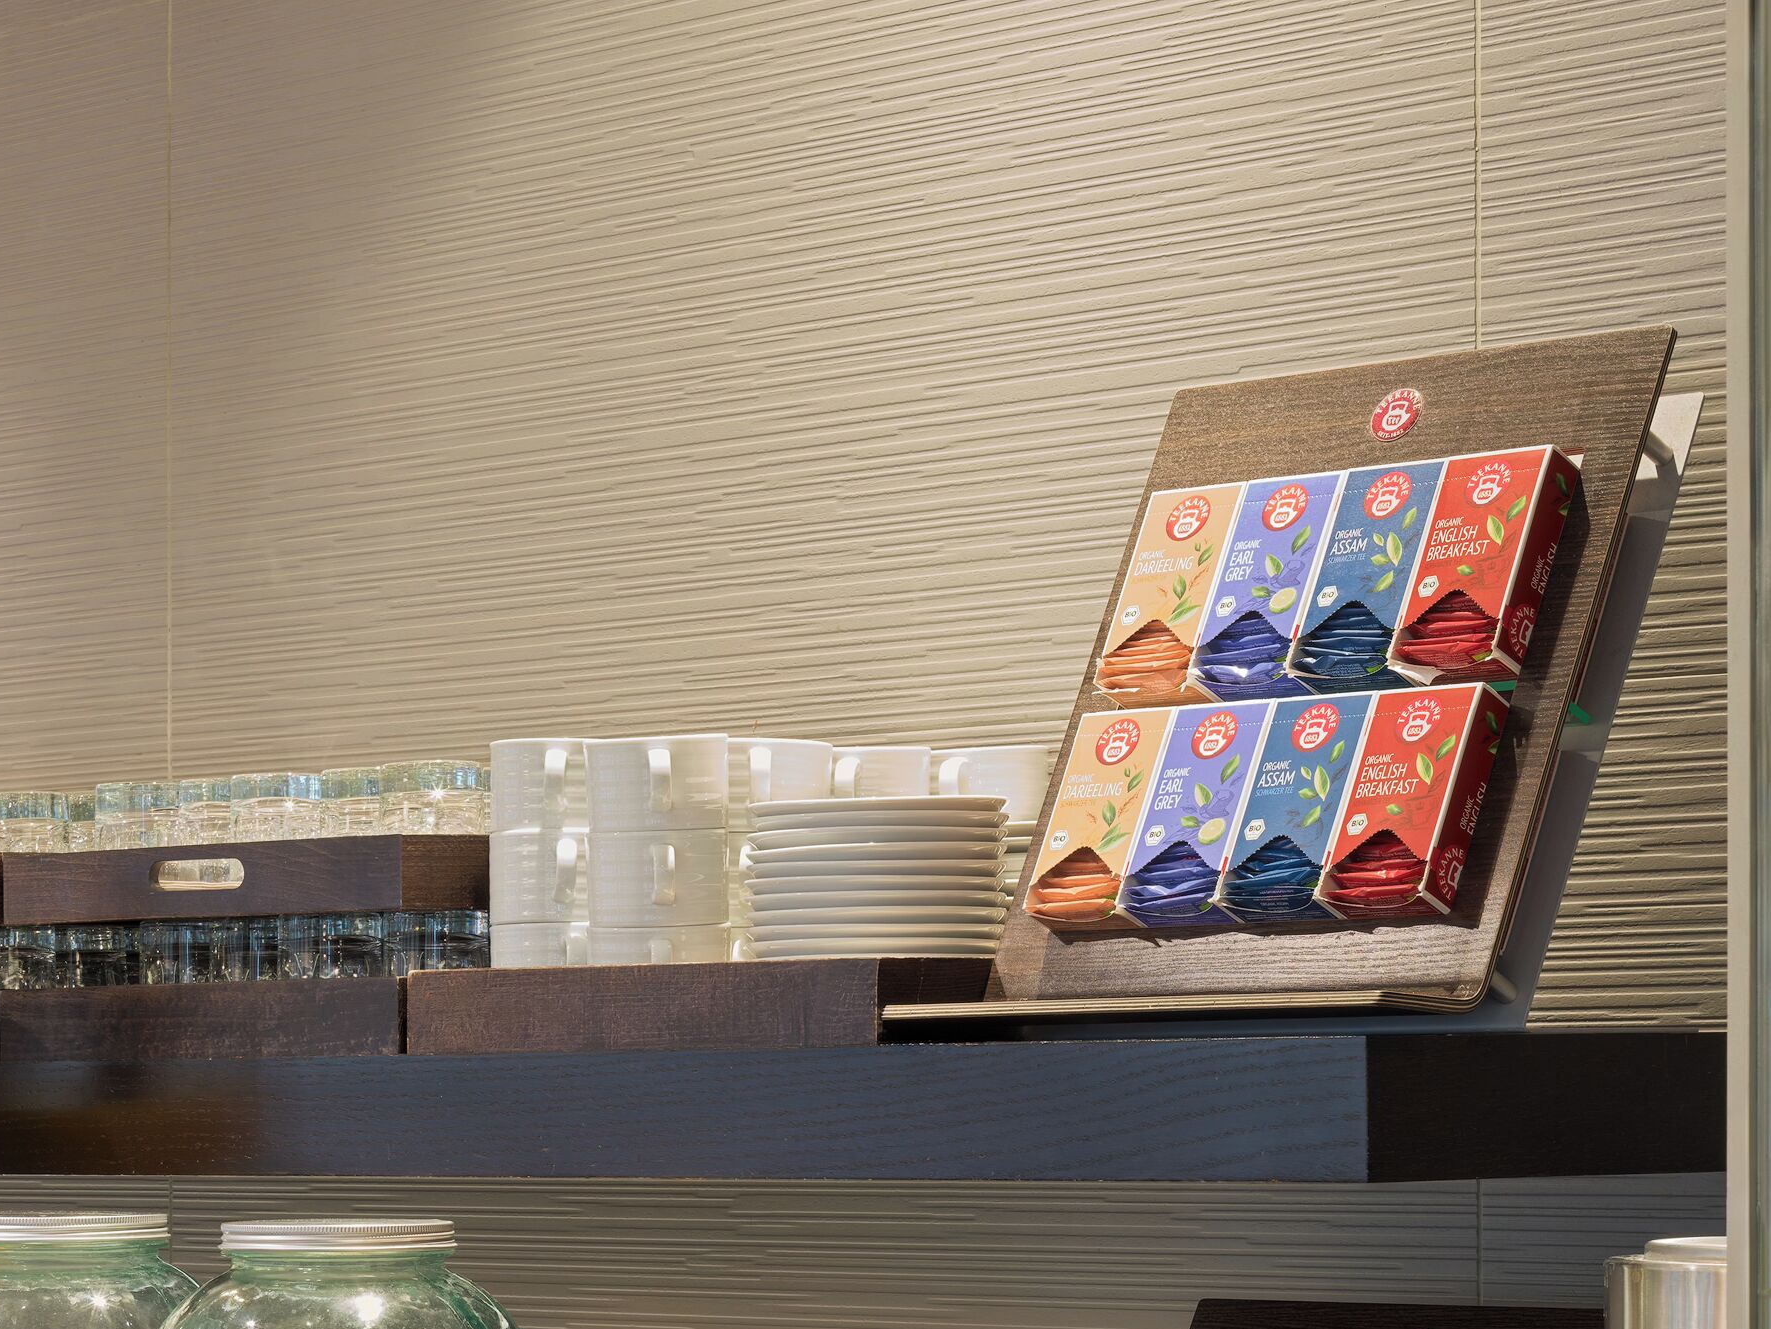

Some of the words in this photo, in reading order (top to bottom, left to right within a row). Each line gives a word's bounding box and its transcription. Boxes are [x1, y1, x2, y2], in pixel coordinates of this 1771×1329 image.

[1375, 391, 1421, 414] TEEKANNE
[1467, 462, 1511, 488] TEEKANNE
[1366, 475, 1410, 500] TEEKANNE
[1169, 497, 1209, 522] TEEKANNE
[1265, 487, 1306, 512] TEEKANNE
[1435, 516, 1464, 529] ORGANIC
[1334, 527, 1364, 540] ORGANIC
[1431, 525, 1478, 545] ENGLISH
[1139, 549, 1166, 560] ORGANIC
[1234, 539, 1262, 551] ORGANIC
[1330, 537, 1368, 556] ASSAM
[1426, 540, 1490, 561] BREAKFAST
[1134, 556, 1195, 576] DARJEELING
[1229, 550, 1254, 566] EARL
[1225, 565, 1253, 581] GREY
[1530, 555, 1545, 590] ORGANIC
[1510, 606, 1536, 659] TEEKANNE
[1294, 706, 1337, 732] TEEKANNE
[1397, 698, 1441, 724] TEEKANNE
[1098, 720, 1140, 746] TEEKANNE
[1194, 714, 1236, 739] TEEKANNE
[1262, 760, 1292, 772] ORGANIC
[1365, 753, 1394, 765] ORGANIC
[1163, 767, 1191, 778] ORGANIC
[1257, 770, 1296, 788] ASSAM
[1360, 763, 1408, 782] ENGLISH
[1063, 781, 1124, 800] DARJEELING
[1158, 778, 1183, 794] EARL
[1355, 779, 1419, 799] BREAKFAST
[1154, 794, 1182, 811] GREY
[1459, 795, 1475, 830] ORGANIC
[1438, 847, 1464, 901] TEEKANNE
